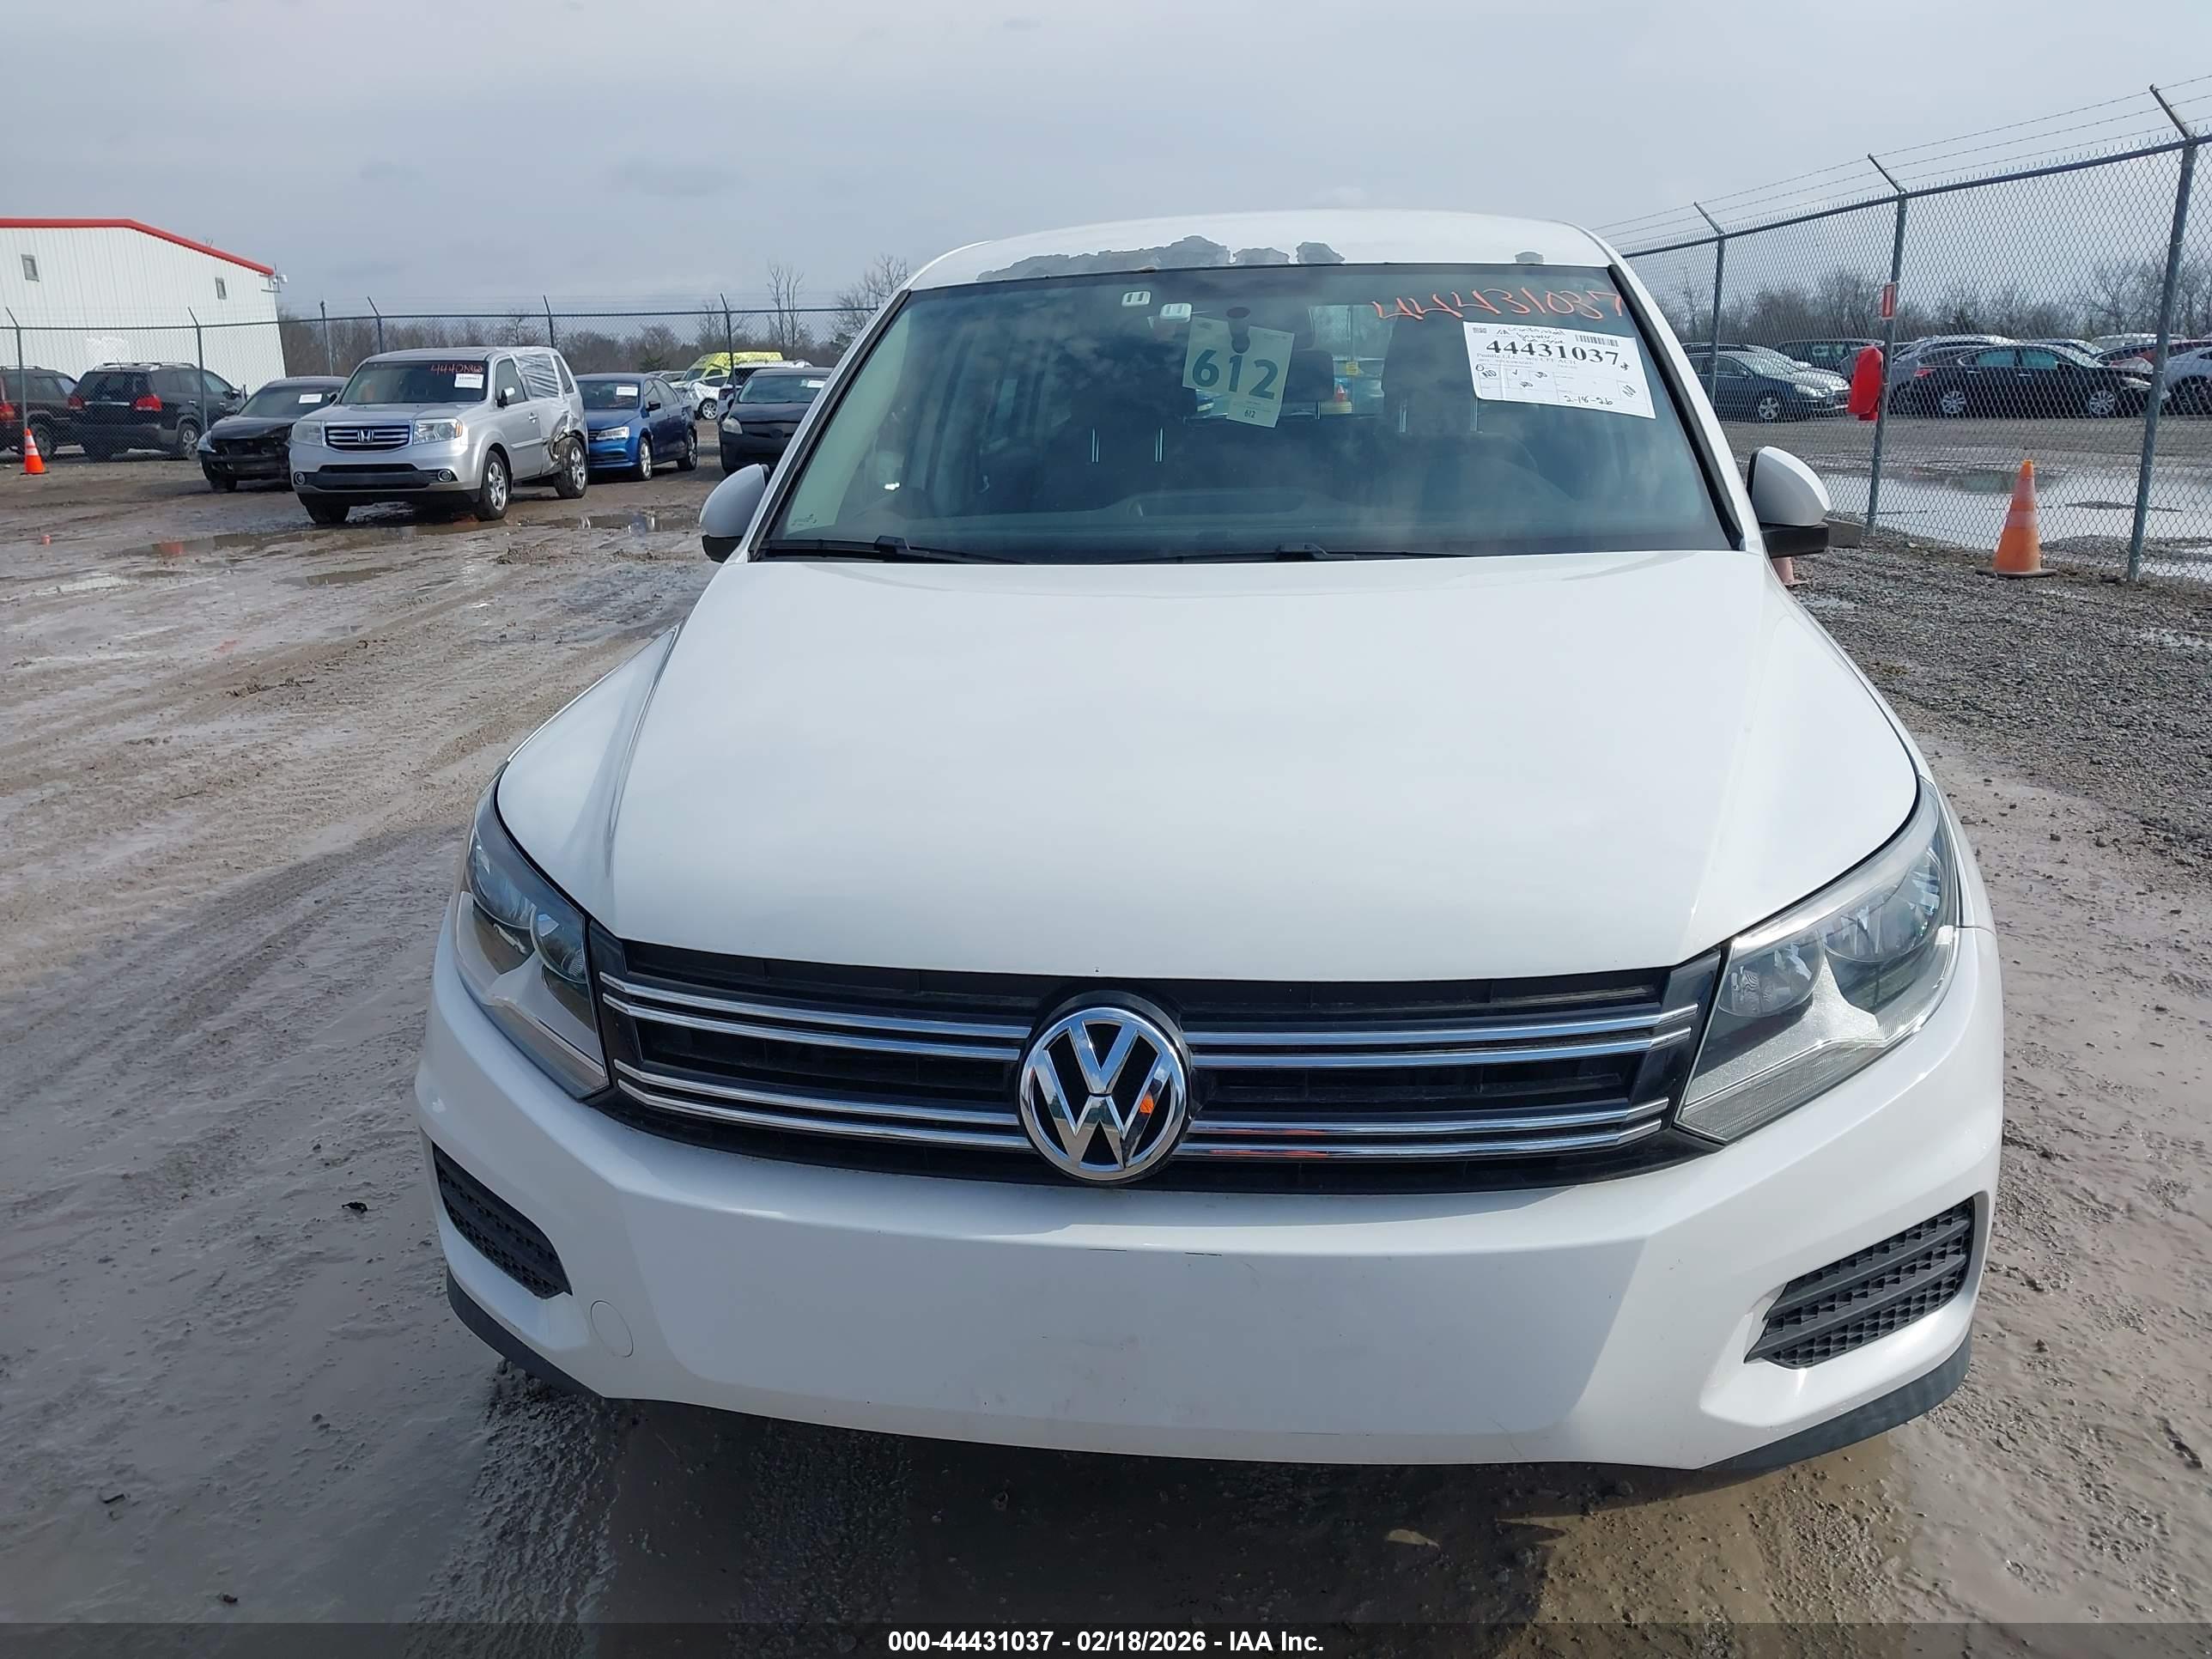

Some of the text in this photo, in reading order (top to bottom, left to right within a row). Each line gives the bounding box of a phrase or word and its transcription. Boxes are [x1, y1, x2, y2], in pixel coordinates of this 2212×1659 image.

[1371, 286, 1622, 320] 44431037
[1486, 340, 1620, 366] 44431037
[1192, 349, 1279, 400] 612
[1244, 409, 1256, 419] 612
